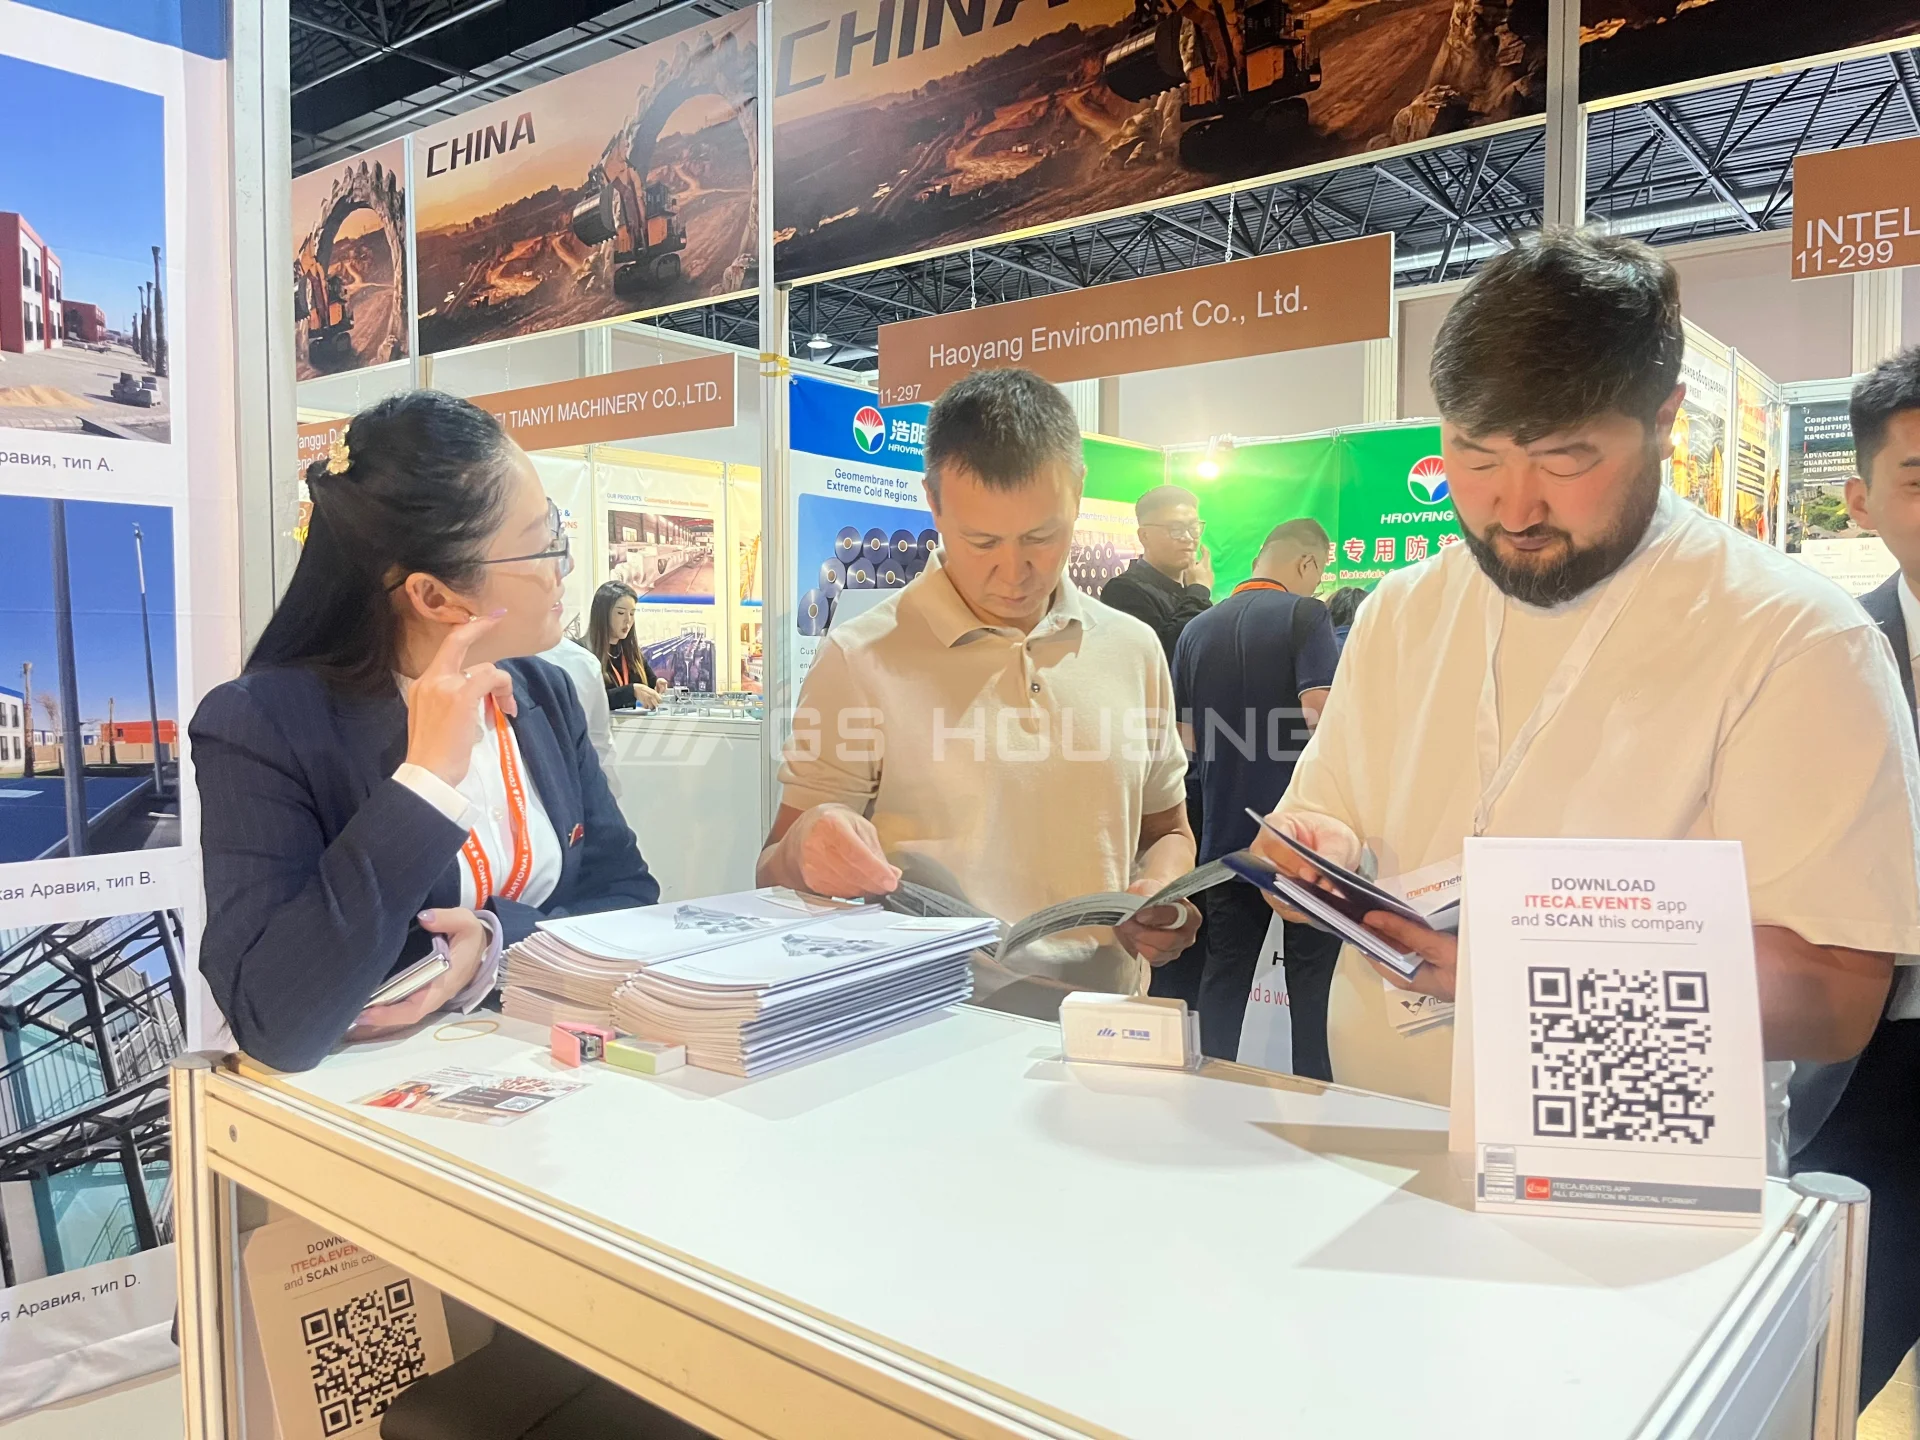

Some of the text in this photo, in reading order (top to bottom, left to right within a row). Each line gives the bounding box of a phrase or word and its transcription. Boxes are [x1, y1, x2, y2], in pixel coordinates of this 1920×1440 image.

[775, 0, 1070, 97] CHIN
[427, 112, 535, 178] CHINA
[1807, 207, 1920, 249] INTEL
[1796, 240, 1893, 273] 11-299
[929, 285, 1309, 368] Haoyang Environment Co., Ltd.
[509, 406, 554, 428] TIANYI
[558, 391, 648, 421] MACHINERY
[652, 381, 722, 408] CO.,LTD.
[878, 384, 922, 405] 11-297
[0, 451, 56, 469] равия,
[62, 457, 91, 470] тип
[1804, 458, 1850, 466] GUARANTEES
[834, 468, 909, 489] Geomembrane for
[617, 494, 641, 502] PRODUCTS
[826, 480, 918, 503] Extreme Cold Regions
[1380, 510, 1454, 525] HAOYANG
[1340, 569, 1386, 579] Materials
[30, 880, 100, 899] Аравия,
[106, 875, 134, 889] тип
[1551, 877, 1656, 893] DOWNLOAD
[1524, 894, 1687, 914] ITECA.EVENTS app
[1511, 913, 1704, 934] and SCAN this company
[1264, 989, 1271, 1003] a
[1552, 1182, 1613, 1193] ITECA.EVENTS
[1552, 1190, 1568, 1198] ALL
[1569, 1191, 1616, 1201] EXHIBITION
[284, 1275, 304, 1291] and
[306, 1265, 339, 1283] SCAN
[341, 1258, 359, 1271] this
[16, 1291, 85, 1318] Аравия,
[91, 1281, 119, 1297] тип
[124, 1274, 141, 1288] D.
